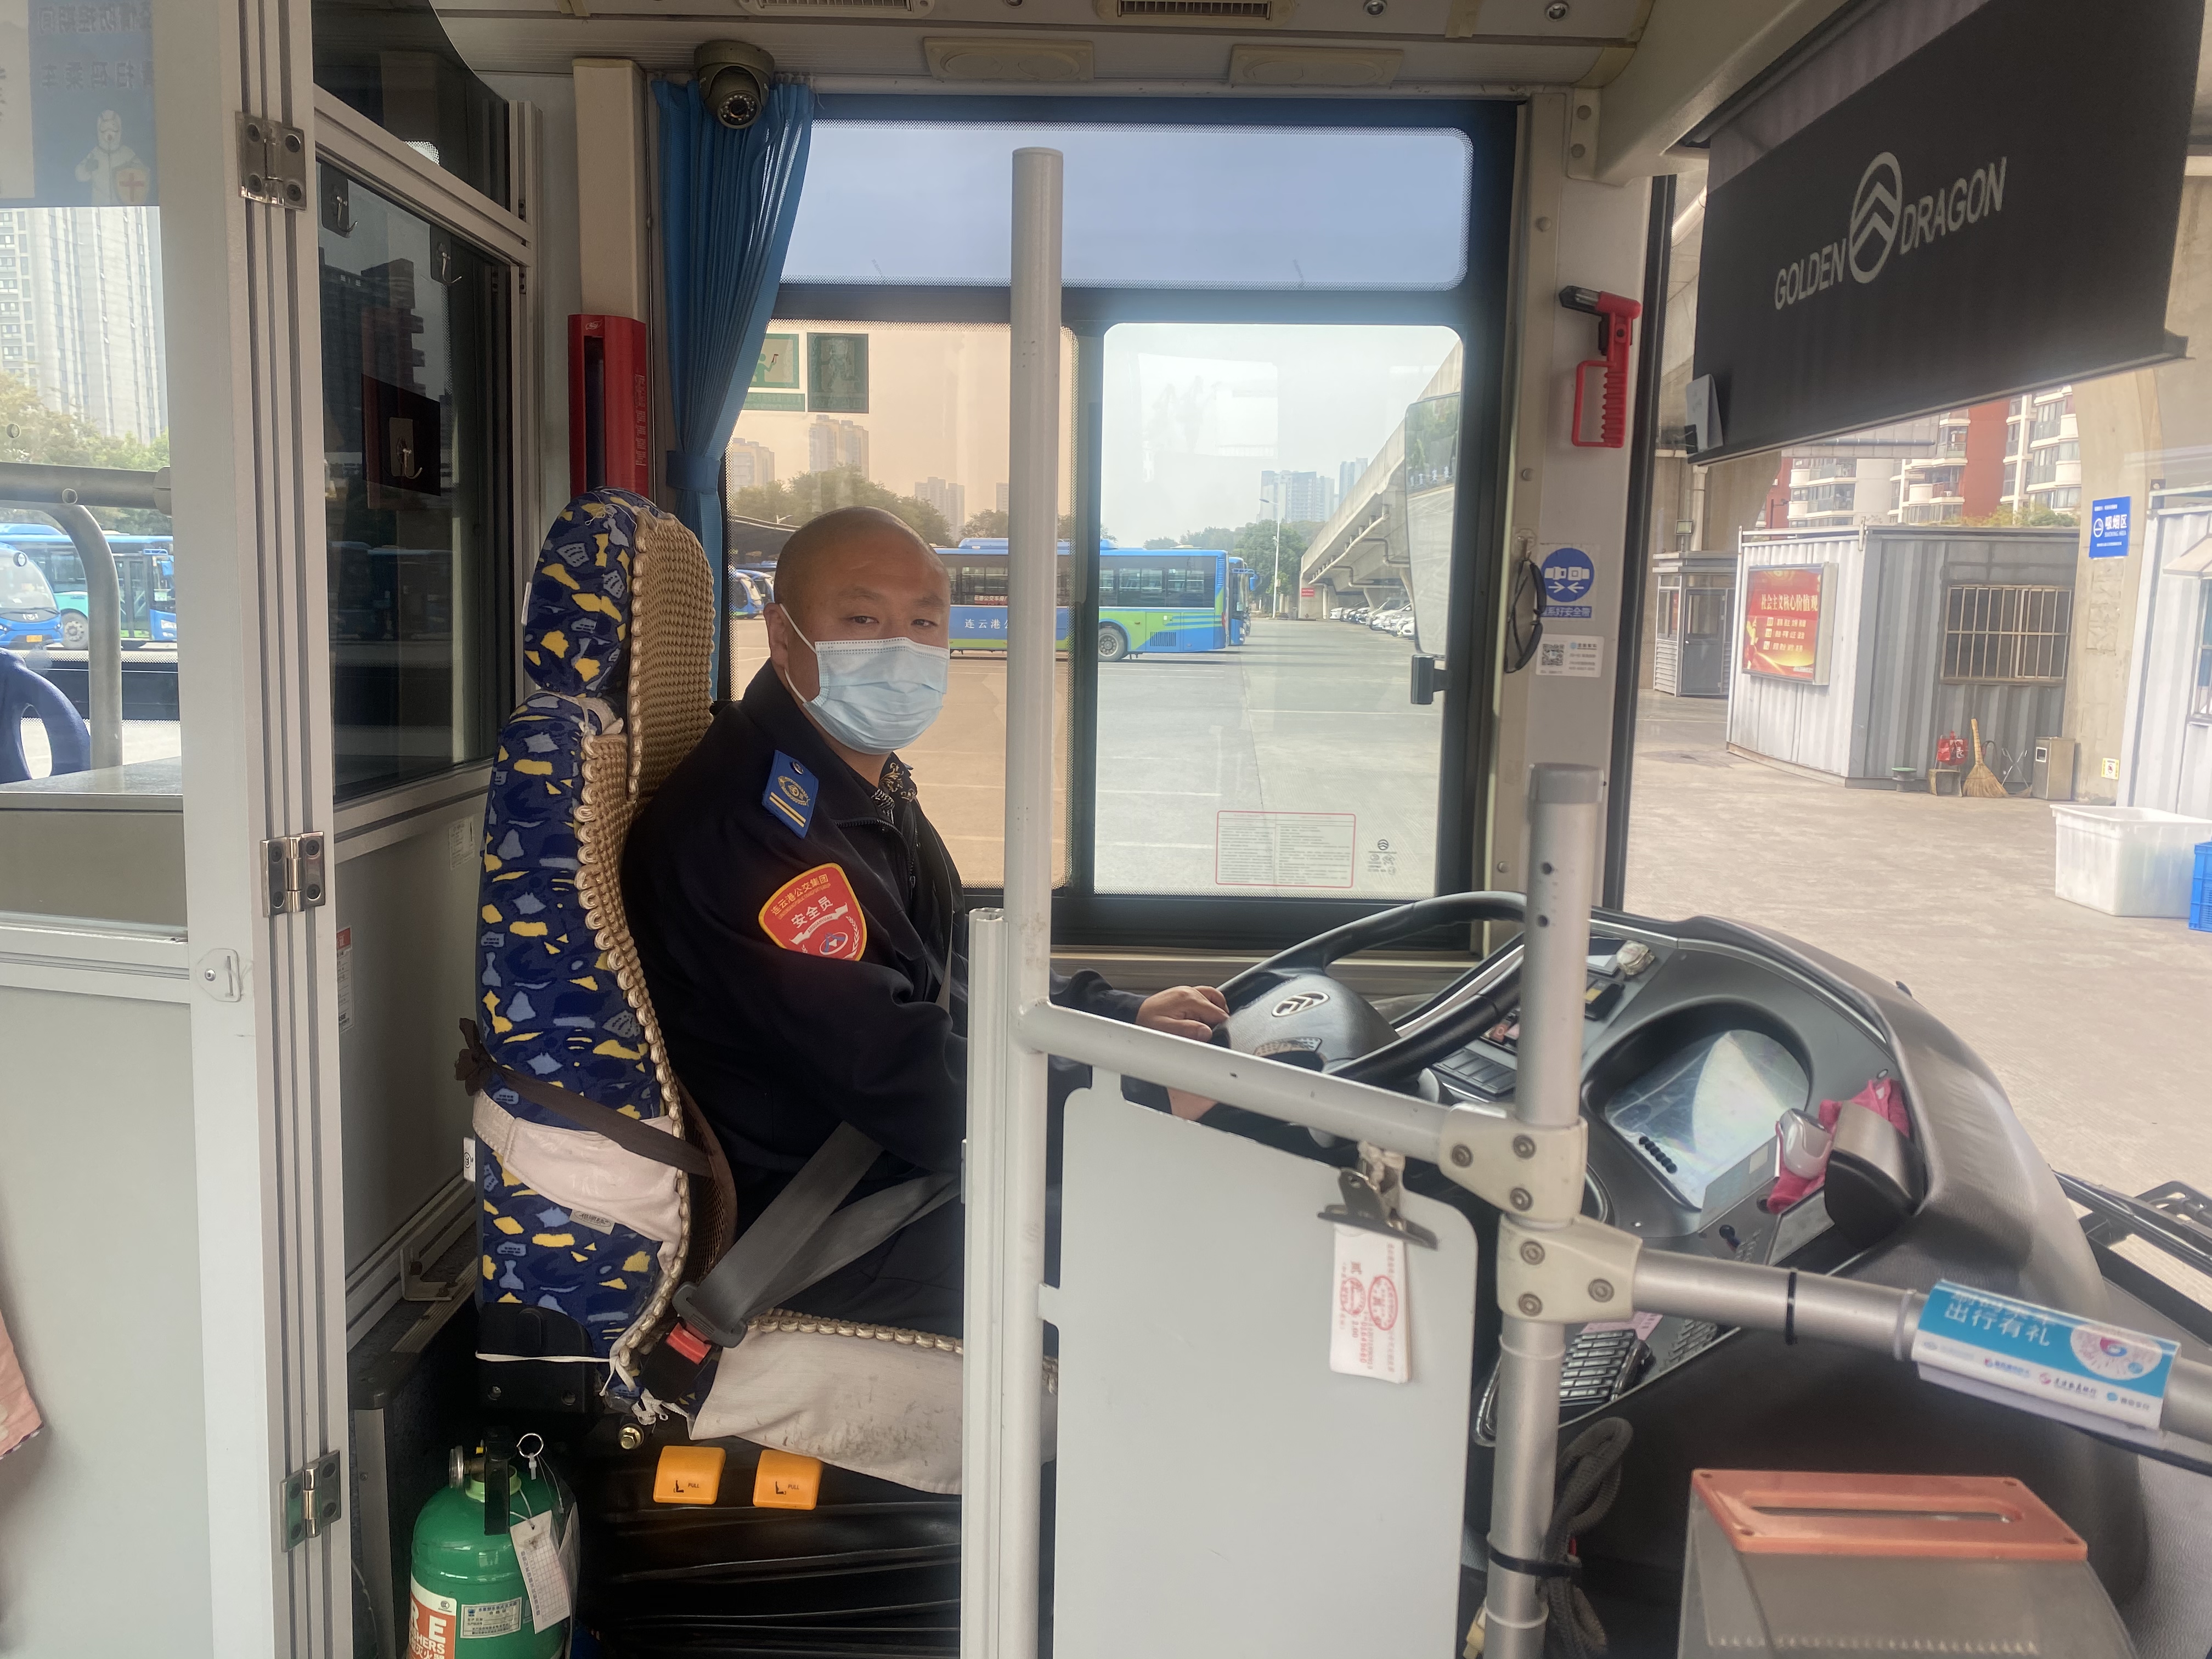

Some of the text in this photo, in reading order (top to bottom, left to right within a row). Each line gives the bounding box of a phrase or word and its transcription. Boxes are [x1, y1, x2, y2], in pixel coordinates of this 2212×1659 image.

[1774, 156, 2007, 311] GOLDEN DRAGON
[1762, 594, 1819, 612] 社会主义核心价值观
[770, 874, 829, 916] 连云港公交集团
[791, 896, 833, 929] 安全员
[808, 916, 833, 934] ANQUANYUAN
[1944, 1301, 2051, 1347] 出行有礼
